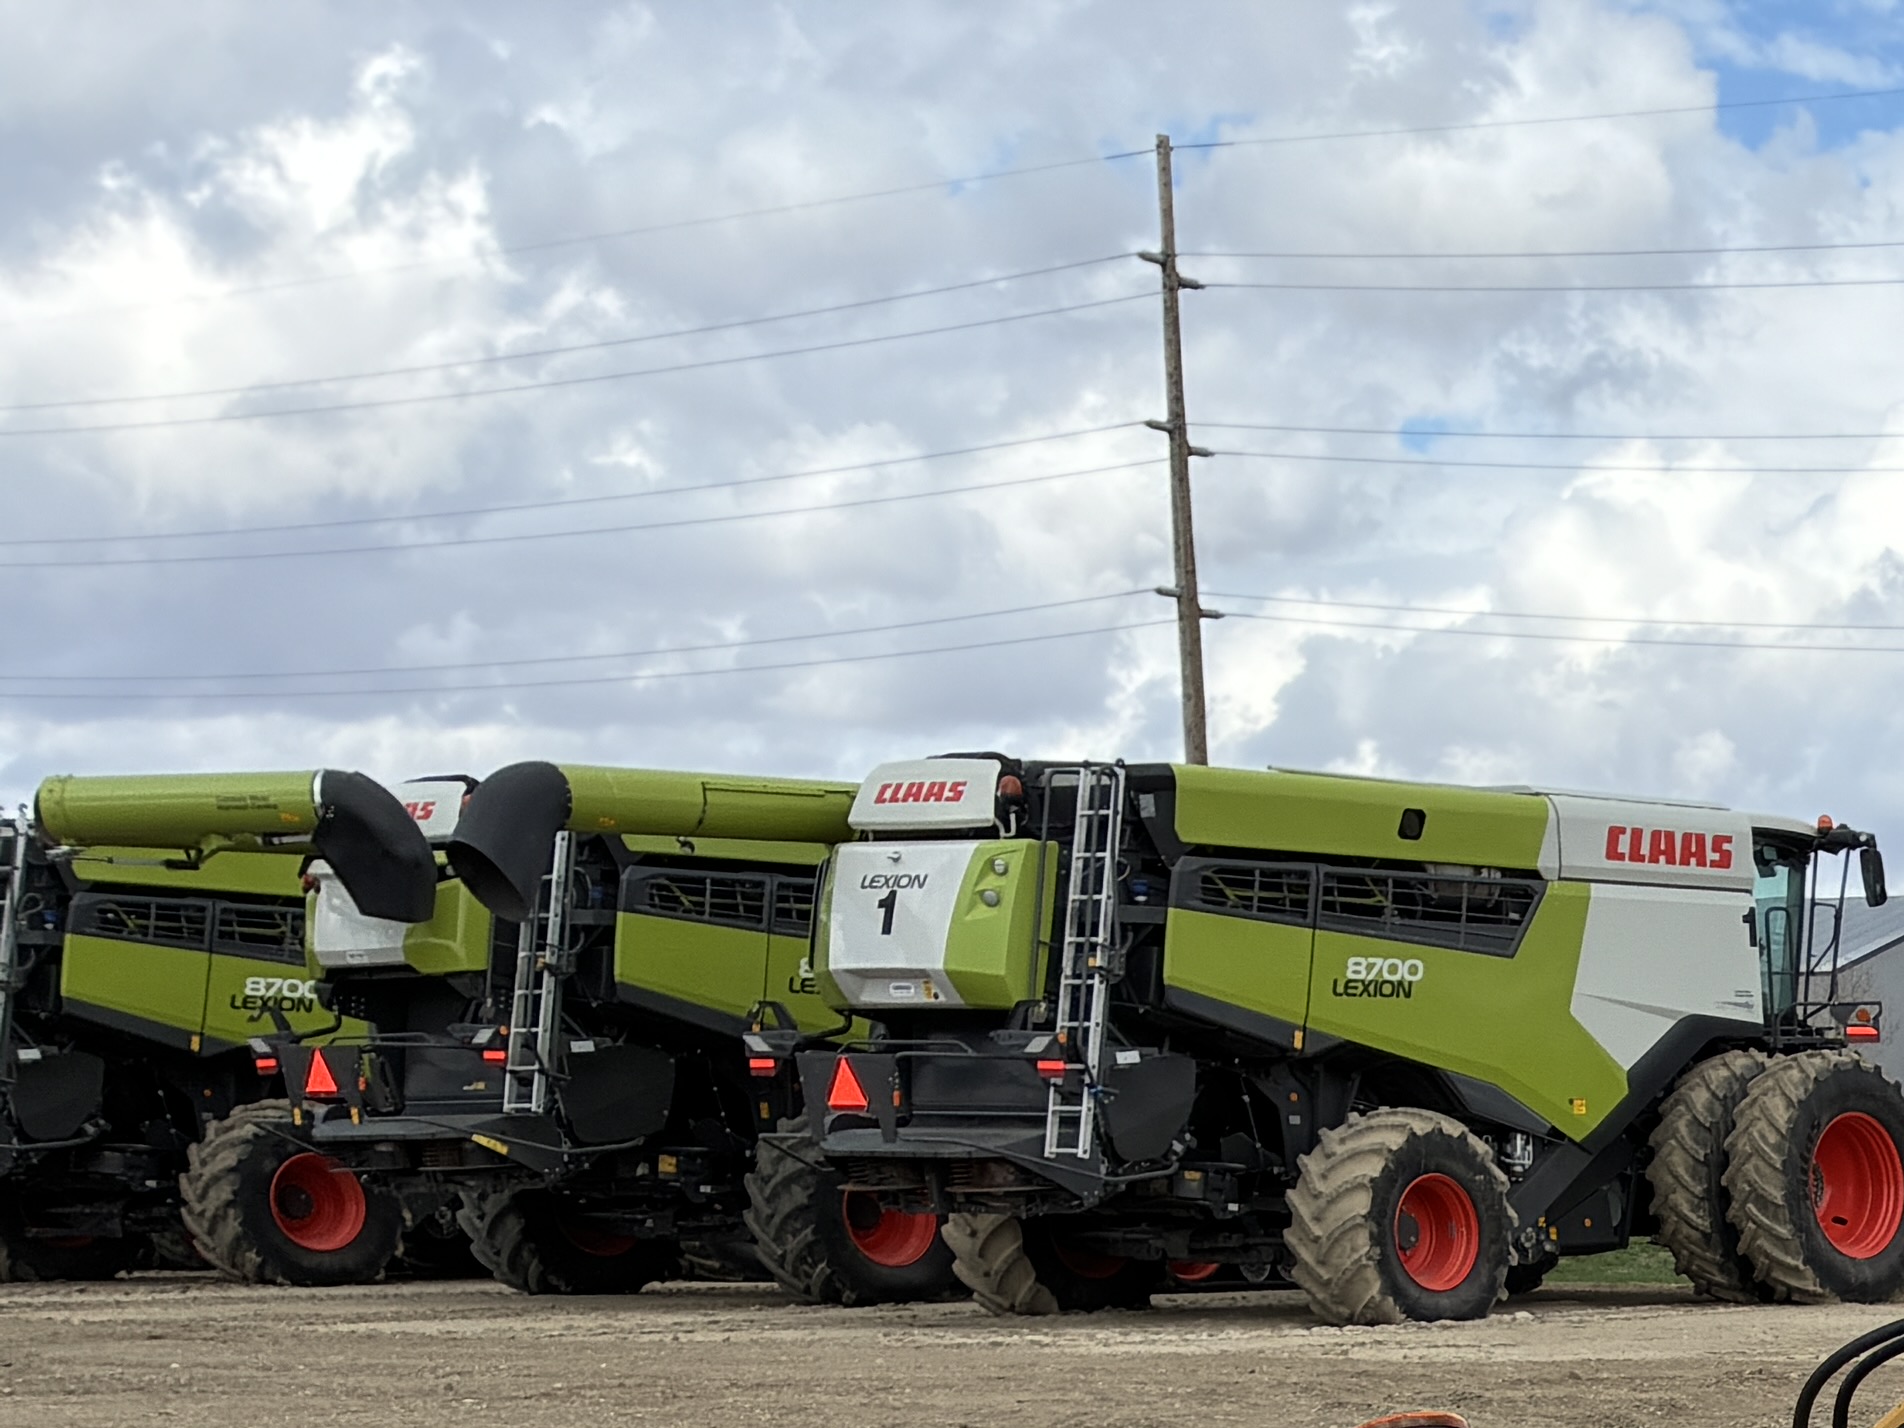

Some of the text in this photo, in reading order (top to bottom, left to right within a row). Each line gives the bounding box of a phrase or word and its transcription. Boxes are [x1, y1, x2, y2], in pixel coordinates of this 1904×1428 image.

[874, 781, 968, 804] CLAAS
[1605, 825, 1733, 869] CLAAS
[860, 873, 928, 889] LEXION
[877, 889, 898, 935] 1
[1346, 956, 1423, 981] 8700
[1332, 978, 1413, 998] LEXION
[230, 994, 313, 1012] LEXION
